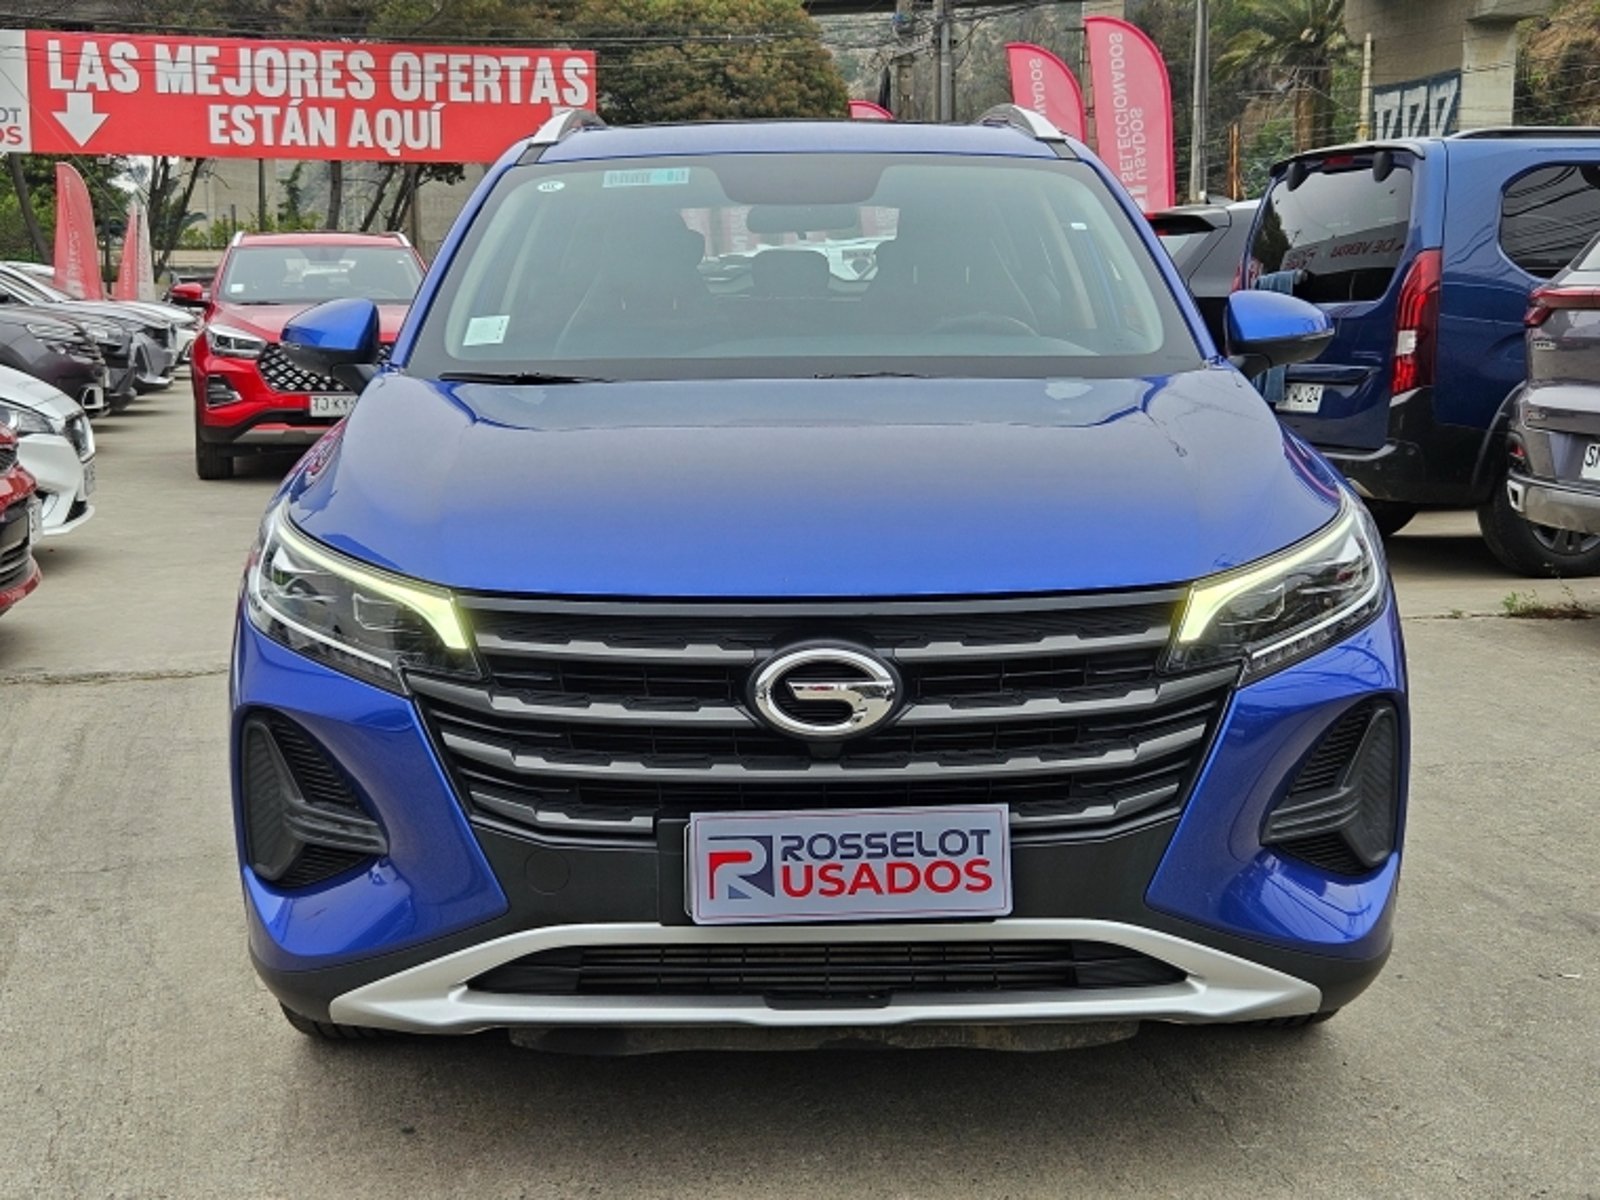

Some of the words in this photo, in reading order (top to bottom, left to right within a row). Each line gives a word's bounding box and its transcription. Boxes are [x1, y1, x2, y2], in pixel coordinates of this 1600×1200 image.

[47, 40, 141, 93] LAS
[154, 43, 376, 101] MEJORES
[389, 52, 590, 107] OFERTAS
[208, 99, 336, 149] ESTÁN
[348, 102, 444, 157] AQUÍ
[780, 828, 991, 862] ROSSELOT
[781, 858, 993, 898] USADOS
